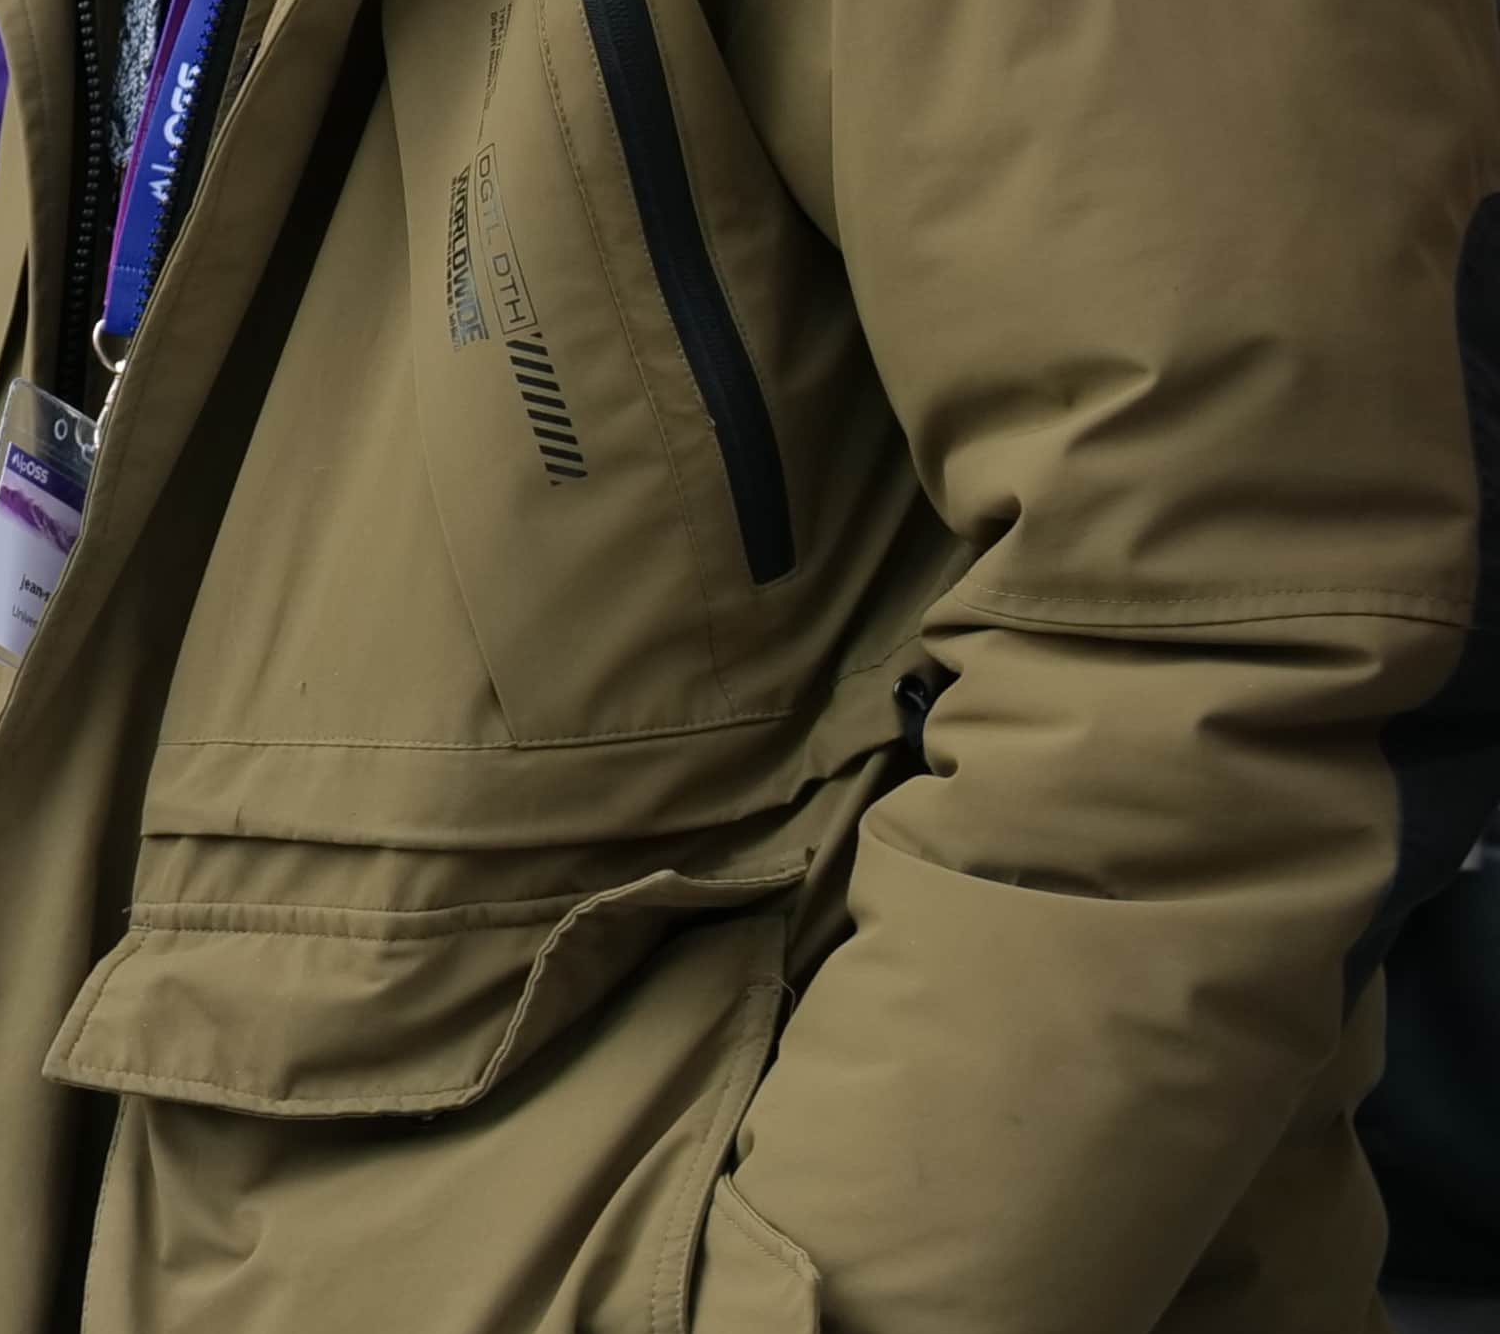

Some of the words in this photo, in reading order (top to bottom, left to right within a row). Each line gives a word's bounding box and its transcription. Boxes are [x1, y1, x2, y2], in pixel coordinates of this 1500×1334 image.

[452, 165, 487, 345] WORLDWIDE
[477, 154, 503, 246] DGTL
[493, 253, 527, 325] DTH
[11, 452, 49, 484] AlpOSS
[19, 574, 50, 603] jean-
